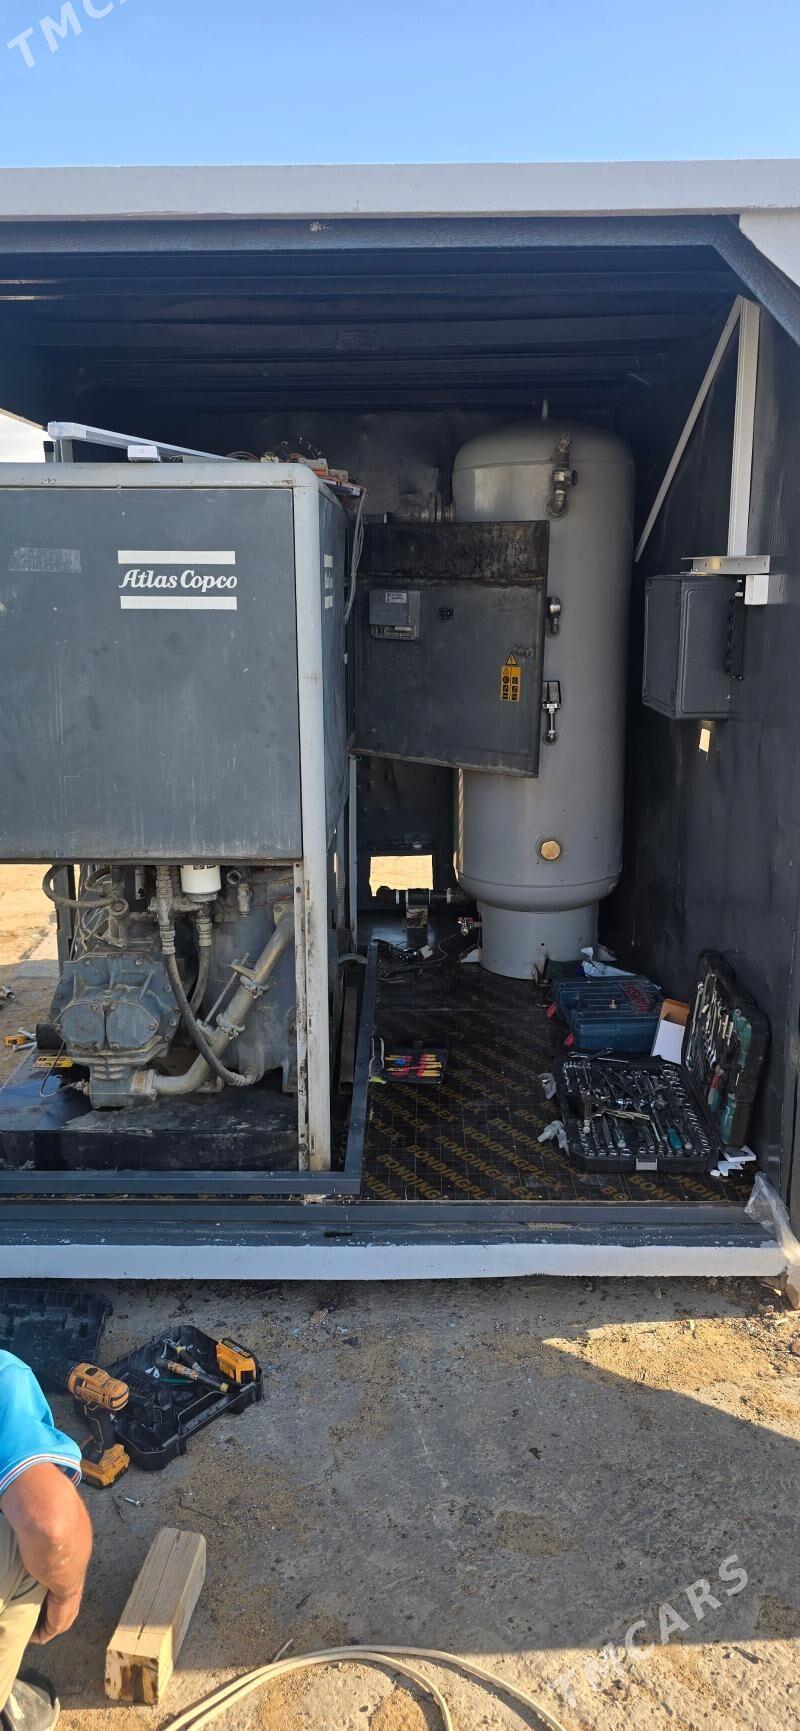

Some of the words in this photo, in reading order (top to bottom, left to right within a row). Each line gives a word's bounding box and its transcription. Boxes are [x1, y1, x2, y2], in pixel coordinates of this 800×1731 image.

[119, 569, 177, 588] Atlas
[180, 569, 238, 593] Copco
[376, 1153, 450, 1200] BONDING
[462, 1126, 567, 1191] BONDINGPLEX
